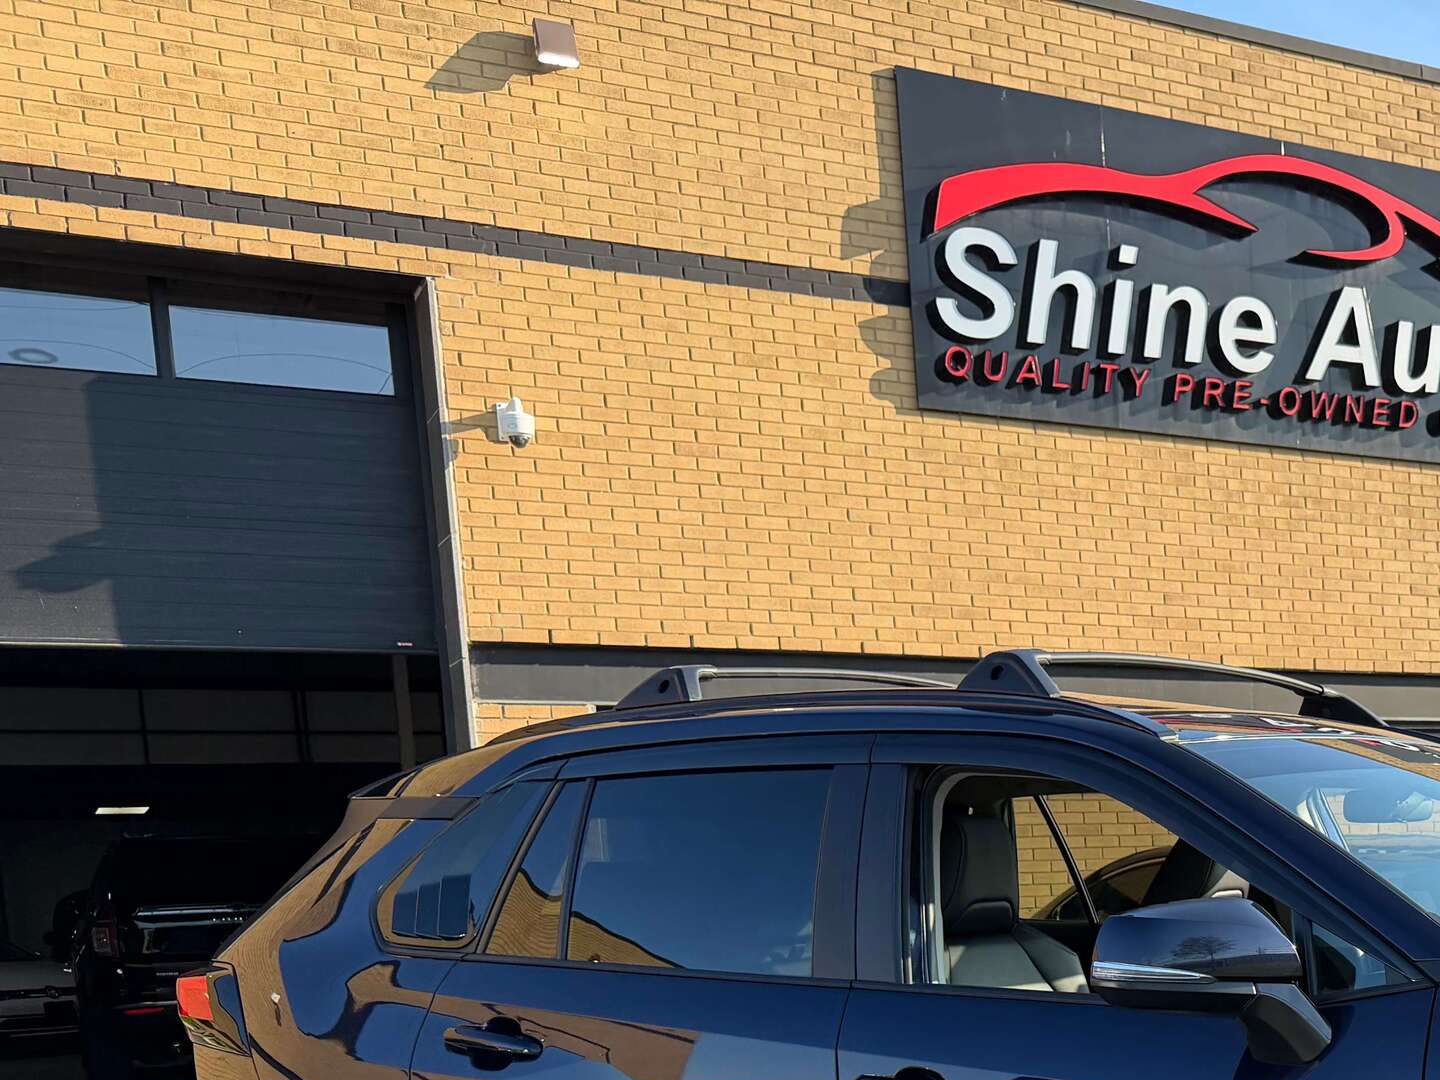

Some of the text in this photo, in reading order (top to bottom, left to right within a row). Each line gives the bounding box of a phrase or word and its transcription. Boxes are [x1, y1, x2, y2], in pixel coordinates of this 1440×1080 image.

[936, 227, 1277, 373] Shine
[944, 345, 1151, 398] QUALITY
[1174, 373, 1419, 430] PRE-OWNED
